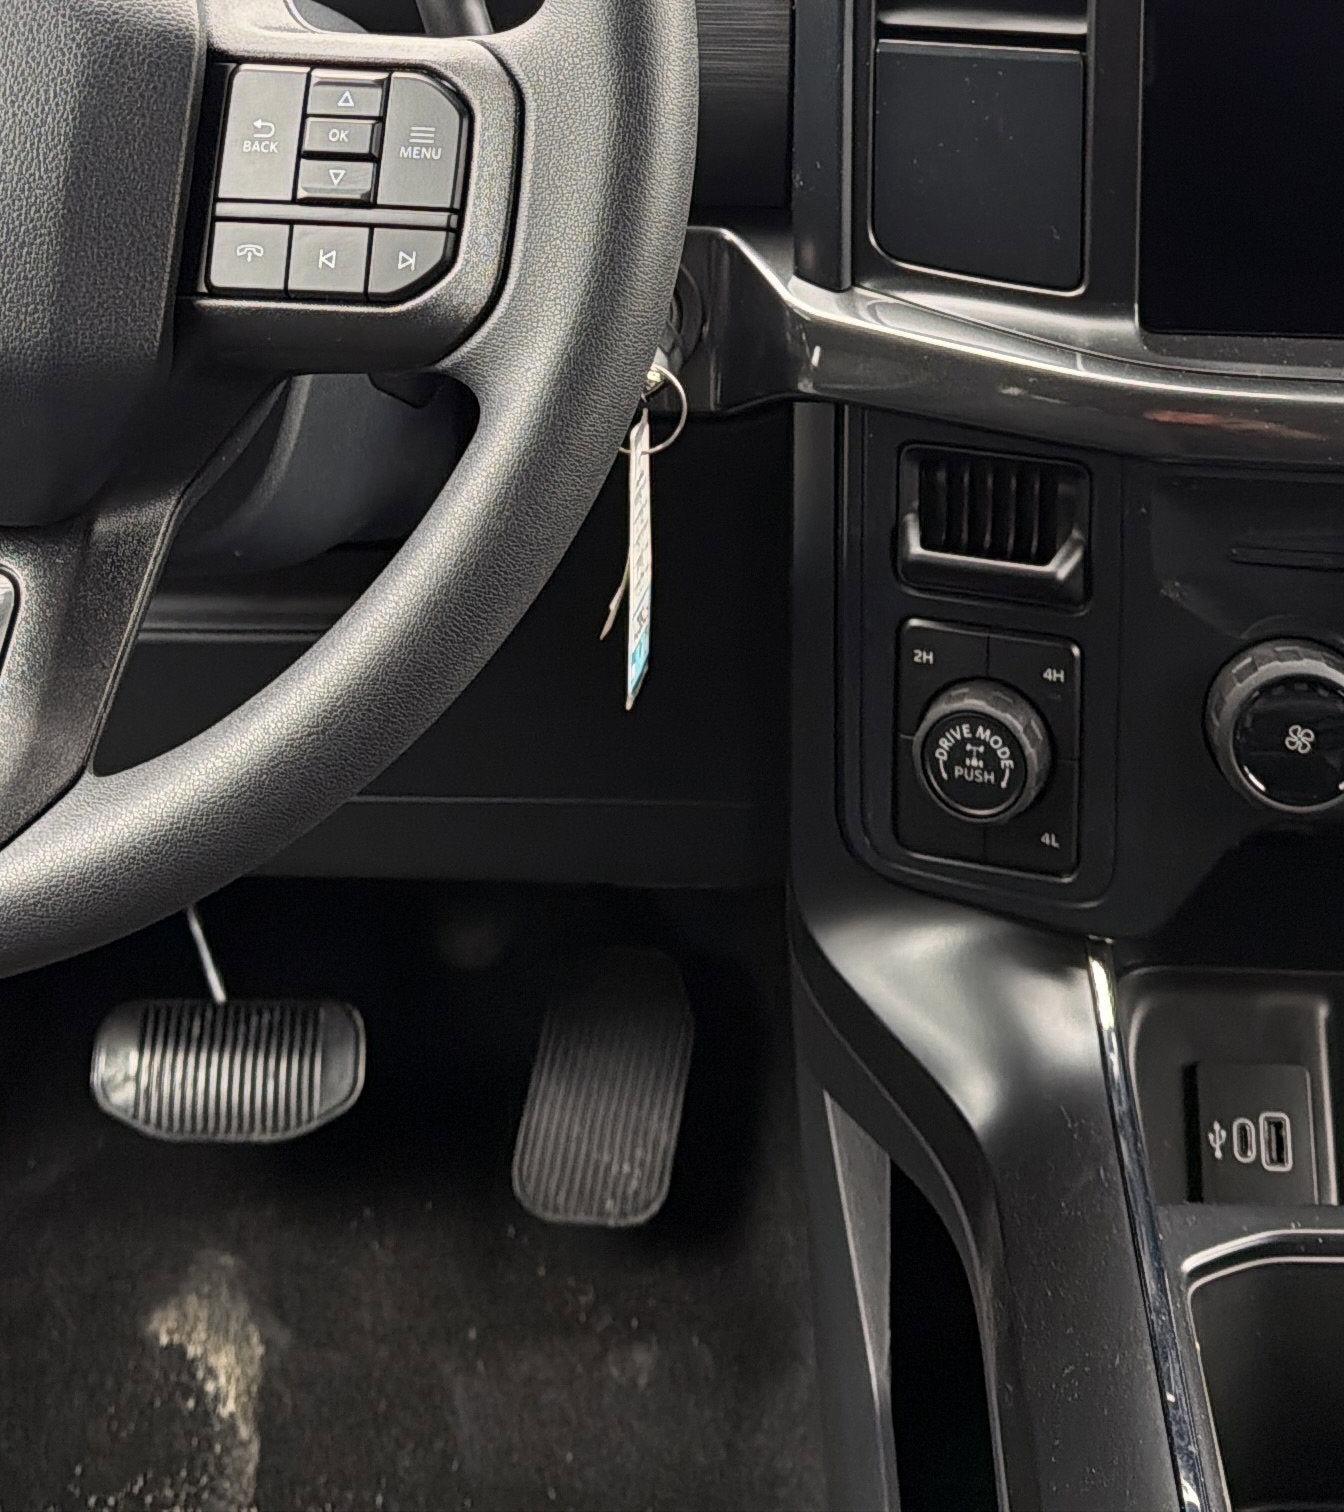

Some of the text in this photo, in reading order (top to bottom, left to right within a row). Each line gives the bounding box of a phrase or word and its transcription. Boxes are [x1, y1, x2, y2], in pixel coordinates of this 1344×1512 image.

[328, 128, 350, 143] OK
[241, 139, 279, 154] BACK
[399, 146, 442, 161] MENU
[912, 649, 934, 665] 2H
[1042, 667, 1065, 683] 4H
[934, 723, 1015, 770] DRIVE MODE
[954, 765, 996, 785] PUSH
[1040, 832, 1060, 849] 4L
